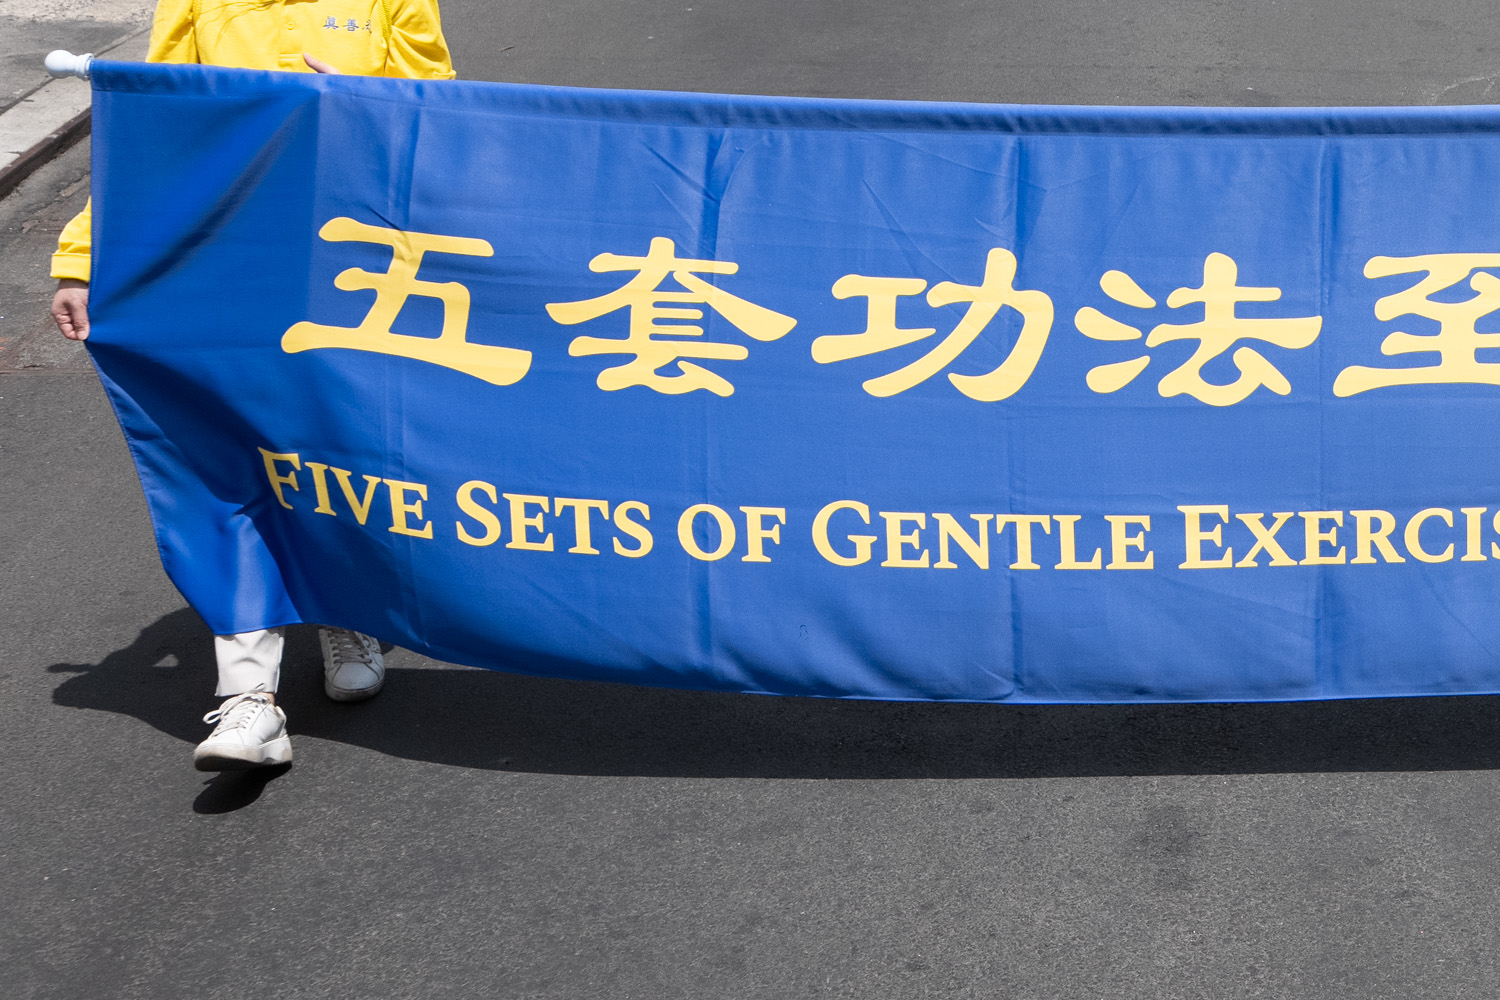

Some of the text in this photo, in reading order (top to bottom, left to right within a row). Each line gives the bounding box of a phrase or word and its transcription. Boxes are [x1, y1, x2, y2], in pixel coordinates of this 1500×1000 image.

[258, 446, 434, 541] FIVE
[456, 480, 654, 558] SETS
[677, 502, 787, 563] OF
[811, 499, 1155, 570] GENTLE
